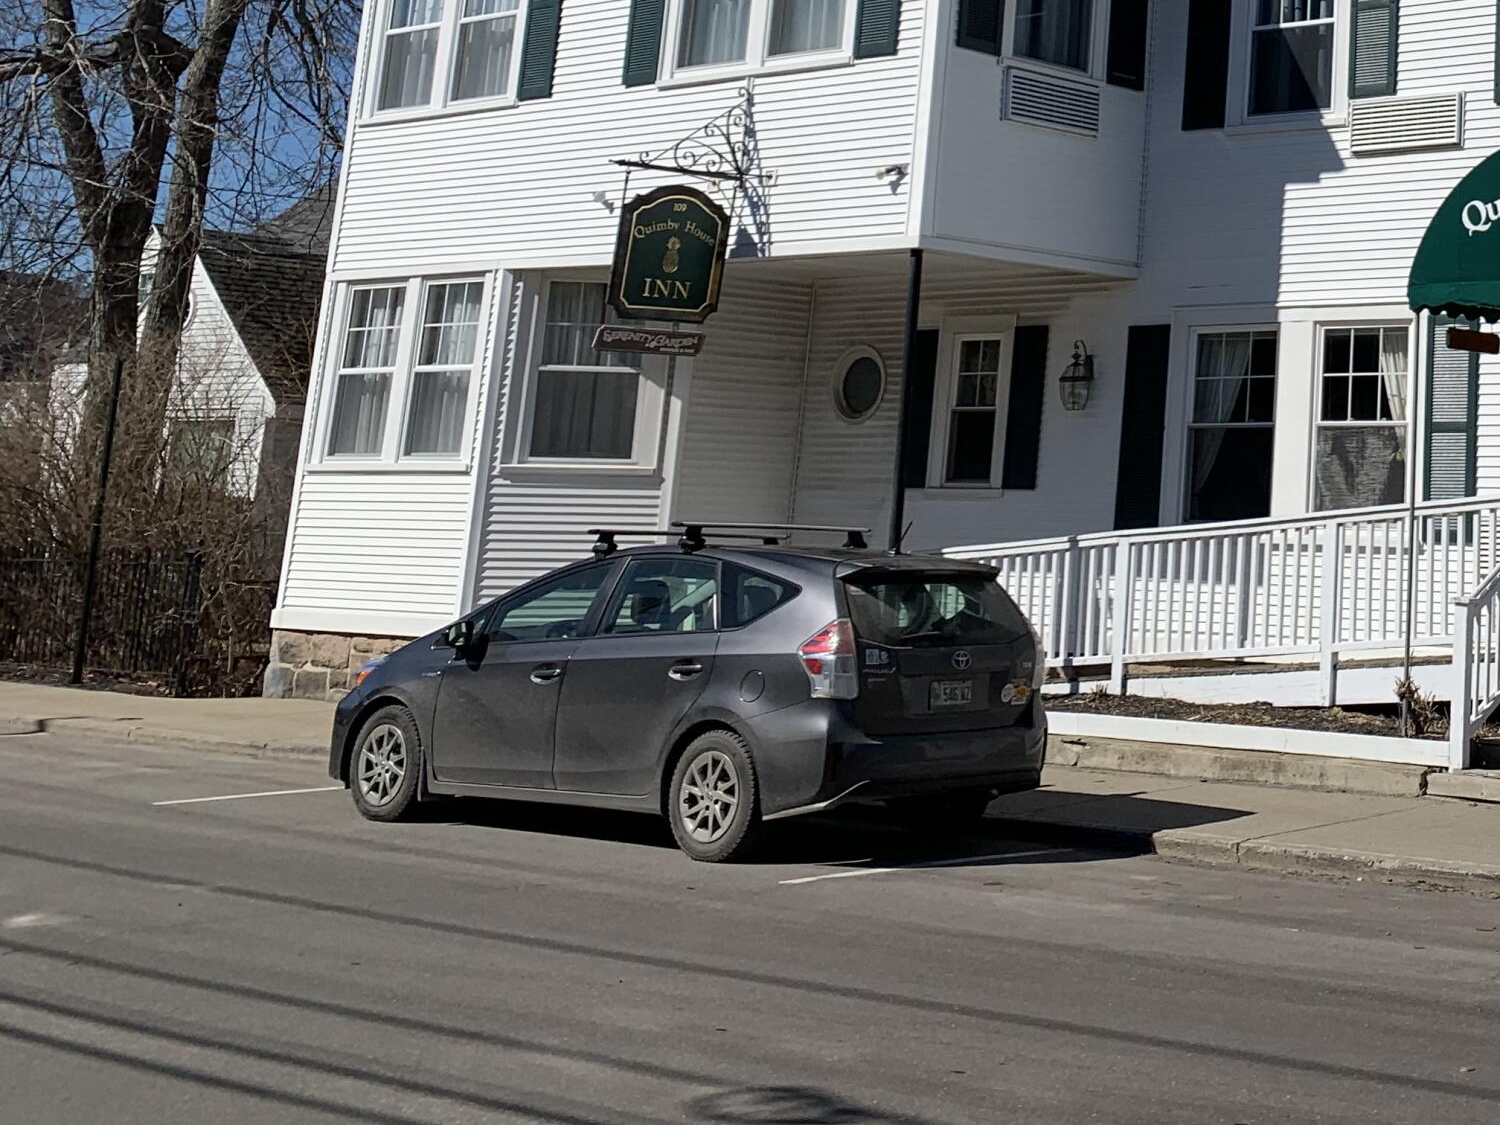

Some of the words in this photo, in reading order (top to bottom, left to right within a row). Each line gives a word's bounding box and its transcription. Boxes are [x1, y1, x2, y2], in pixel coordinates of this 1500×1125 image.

[673, 203, 688, 212] 109
[634, 219, 681, 239] Quimby
[684, 220, 716, 247] House
[642, 278, 692, 299] INN
[602, 329, 655, 343] SERENITY
[645, 334, 699, 348] GARDEN
